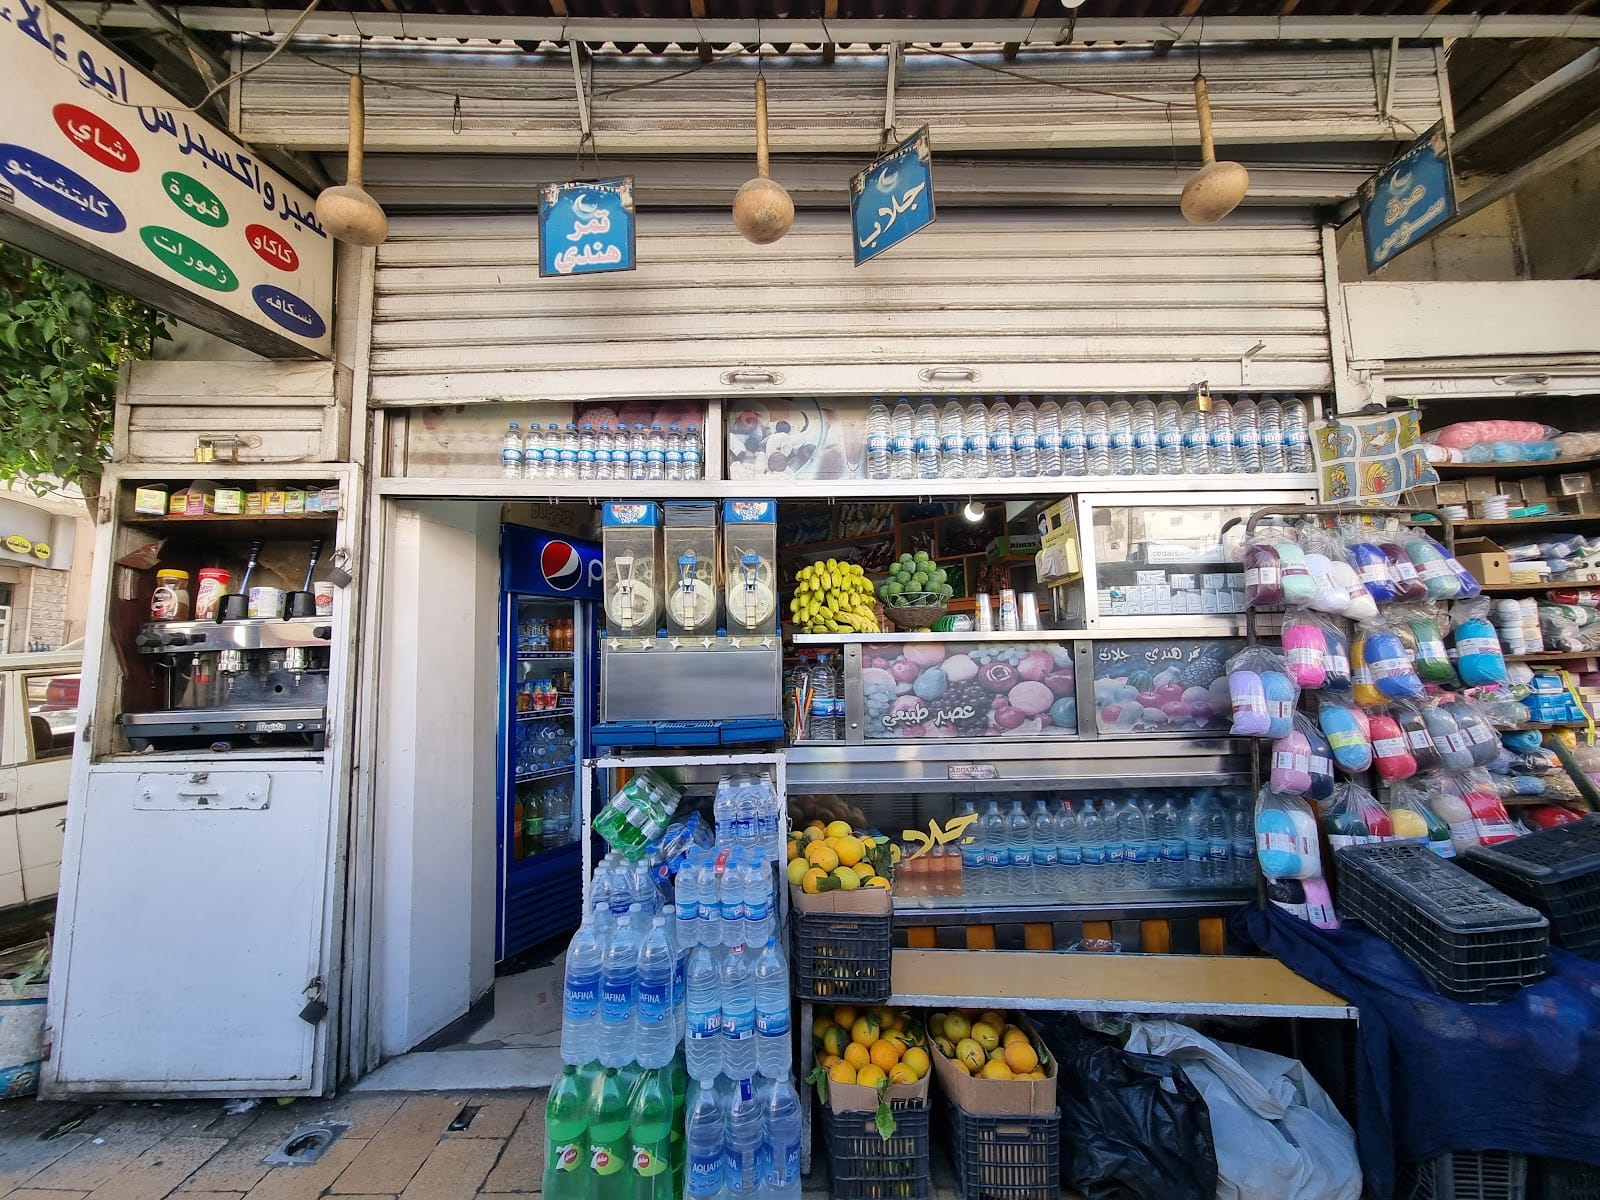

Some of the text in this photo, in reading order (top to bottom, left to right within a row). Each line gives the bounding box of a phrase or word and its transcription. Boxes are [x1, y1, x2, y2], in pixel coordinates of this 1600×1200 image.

[67, 119, 128, 163] شاي
[4, 155, 111, 218] كابتشينو
[169, 177, 221, 220] قهوة
[860, 181, 925, 248] جلاب
[1384, 184, 1426, 227] عرق
[1374, 197, 1446, 262] سوس
[152, 234, 228, 285] زهورات
[252, 236, 293, 265] كاكاو
[554, 242, 621, 274] هندي
[265, 294, 313, 326] نسكافه
[1099, 647, 1130, 664] جلاب
[1144, 646, 1182, 664] هندي
[882, 702, 976, 731] عصير طبيعي
[566, 988, 594, 1001] QUAFINA
